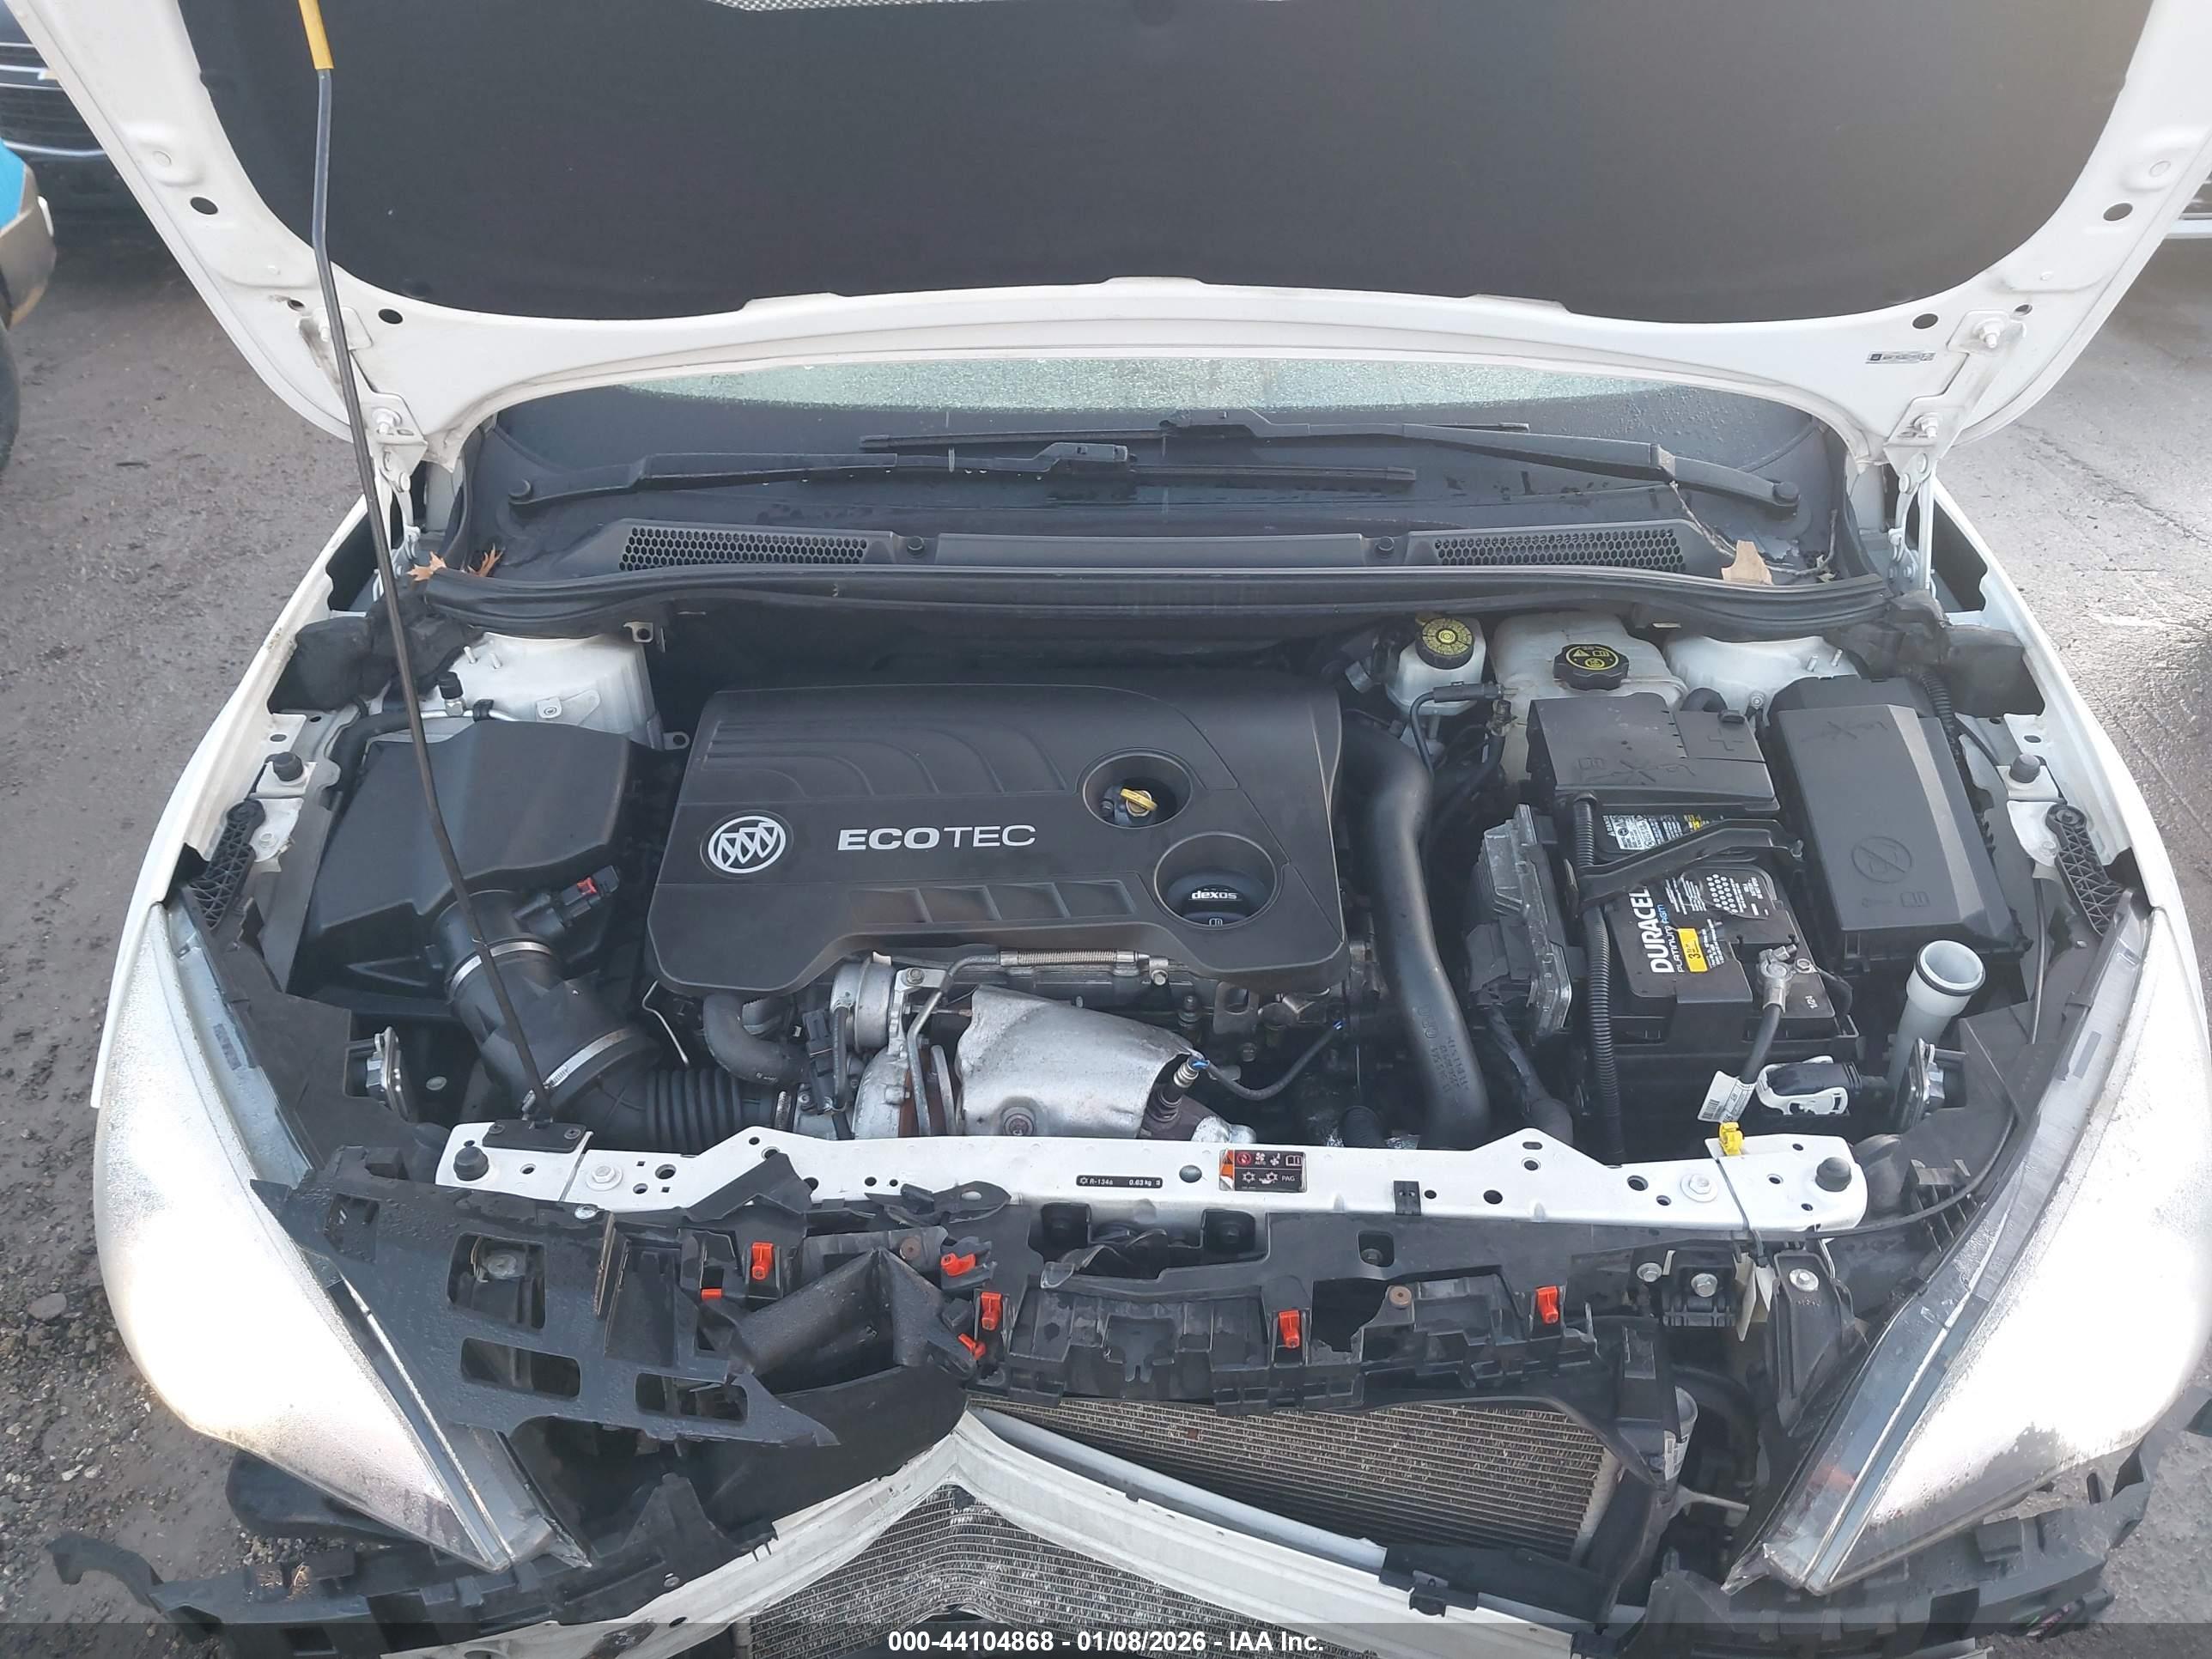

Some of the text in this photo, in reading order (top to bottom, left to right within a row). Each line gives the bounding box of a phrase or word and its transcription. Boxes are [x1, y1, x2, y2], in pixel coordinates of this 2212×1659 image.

[837, 824, 1036, 851] ECOTEC
[1191, 890, 1237, 899] dexos
[1629, 886, 1674, 973] DURACEL
